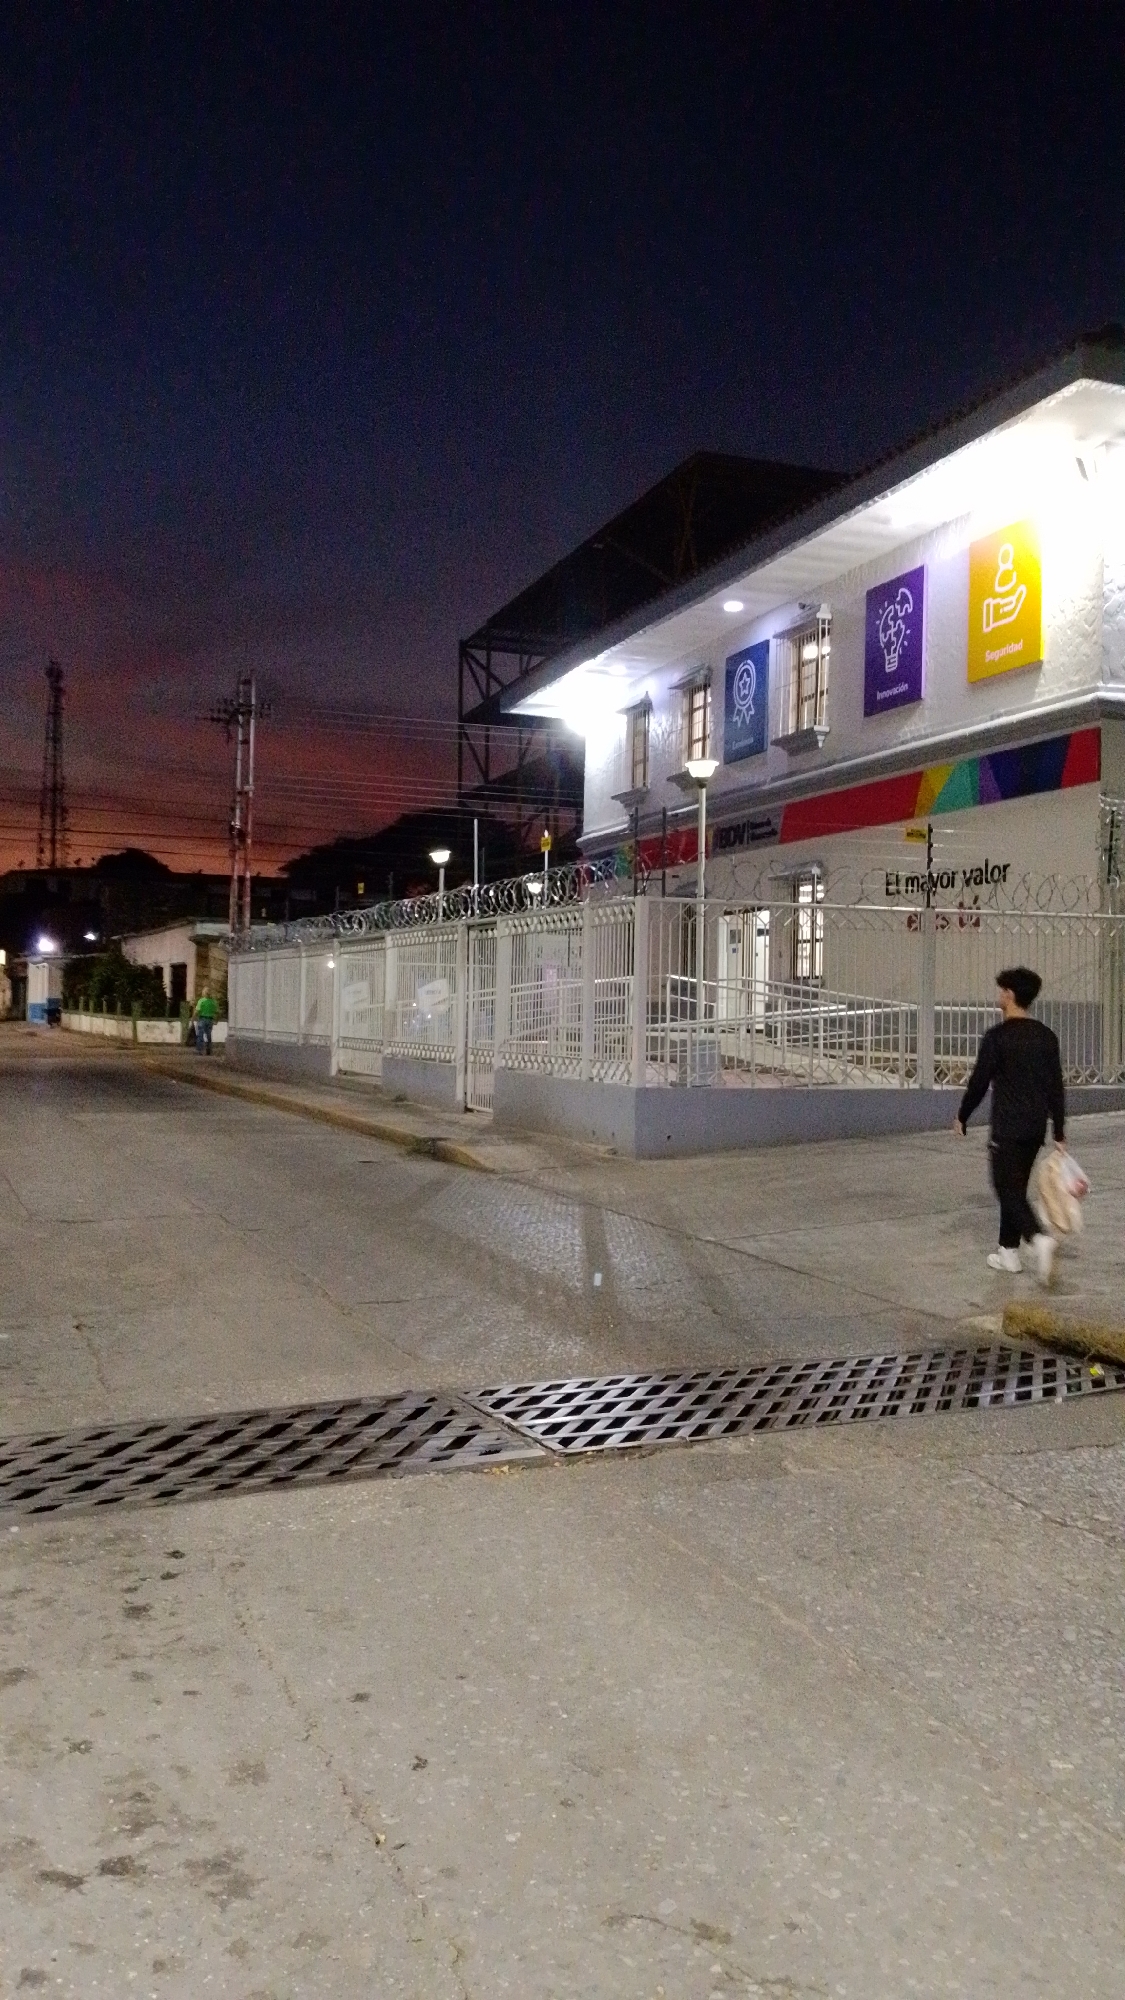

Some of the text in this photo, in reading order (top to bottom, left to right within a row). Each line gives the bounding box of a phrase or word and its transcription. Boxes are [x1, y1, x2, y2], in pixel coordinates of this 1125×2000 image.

[985, 638, 1023, 662] Seguridad
[885, 858, 1012, 897] El mayor valor
[907, 910, 950, 931] es
